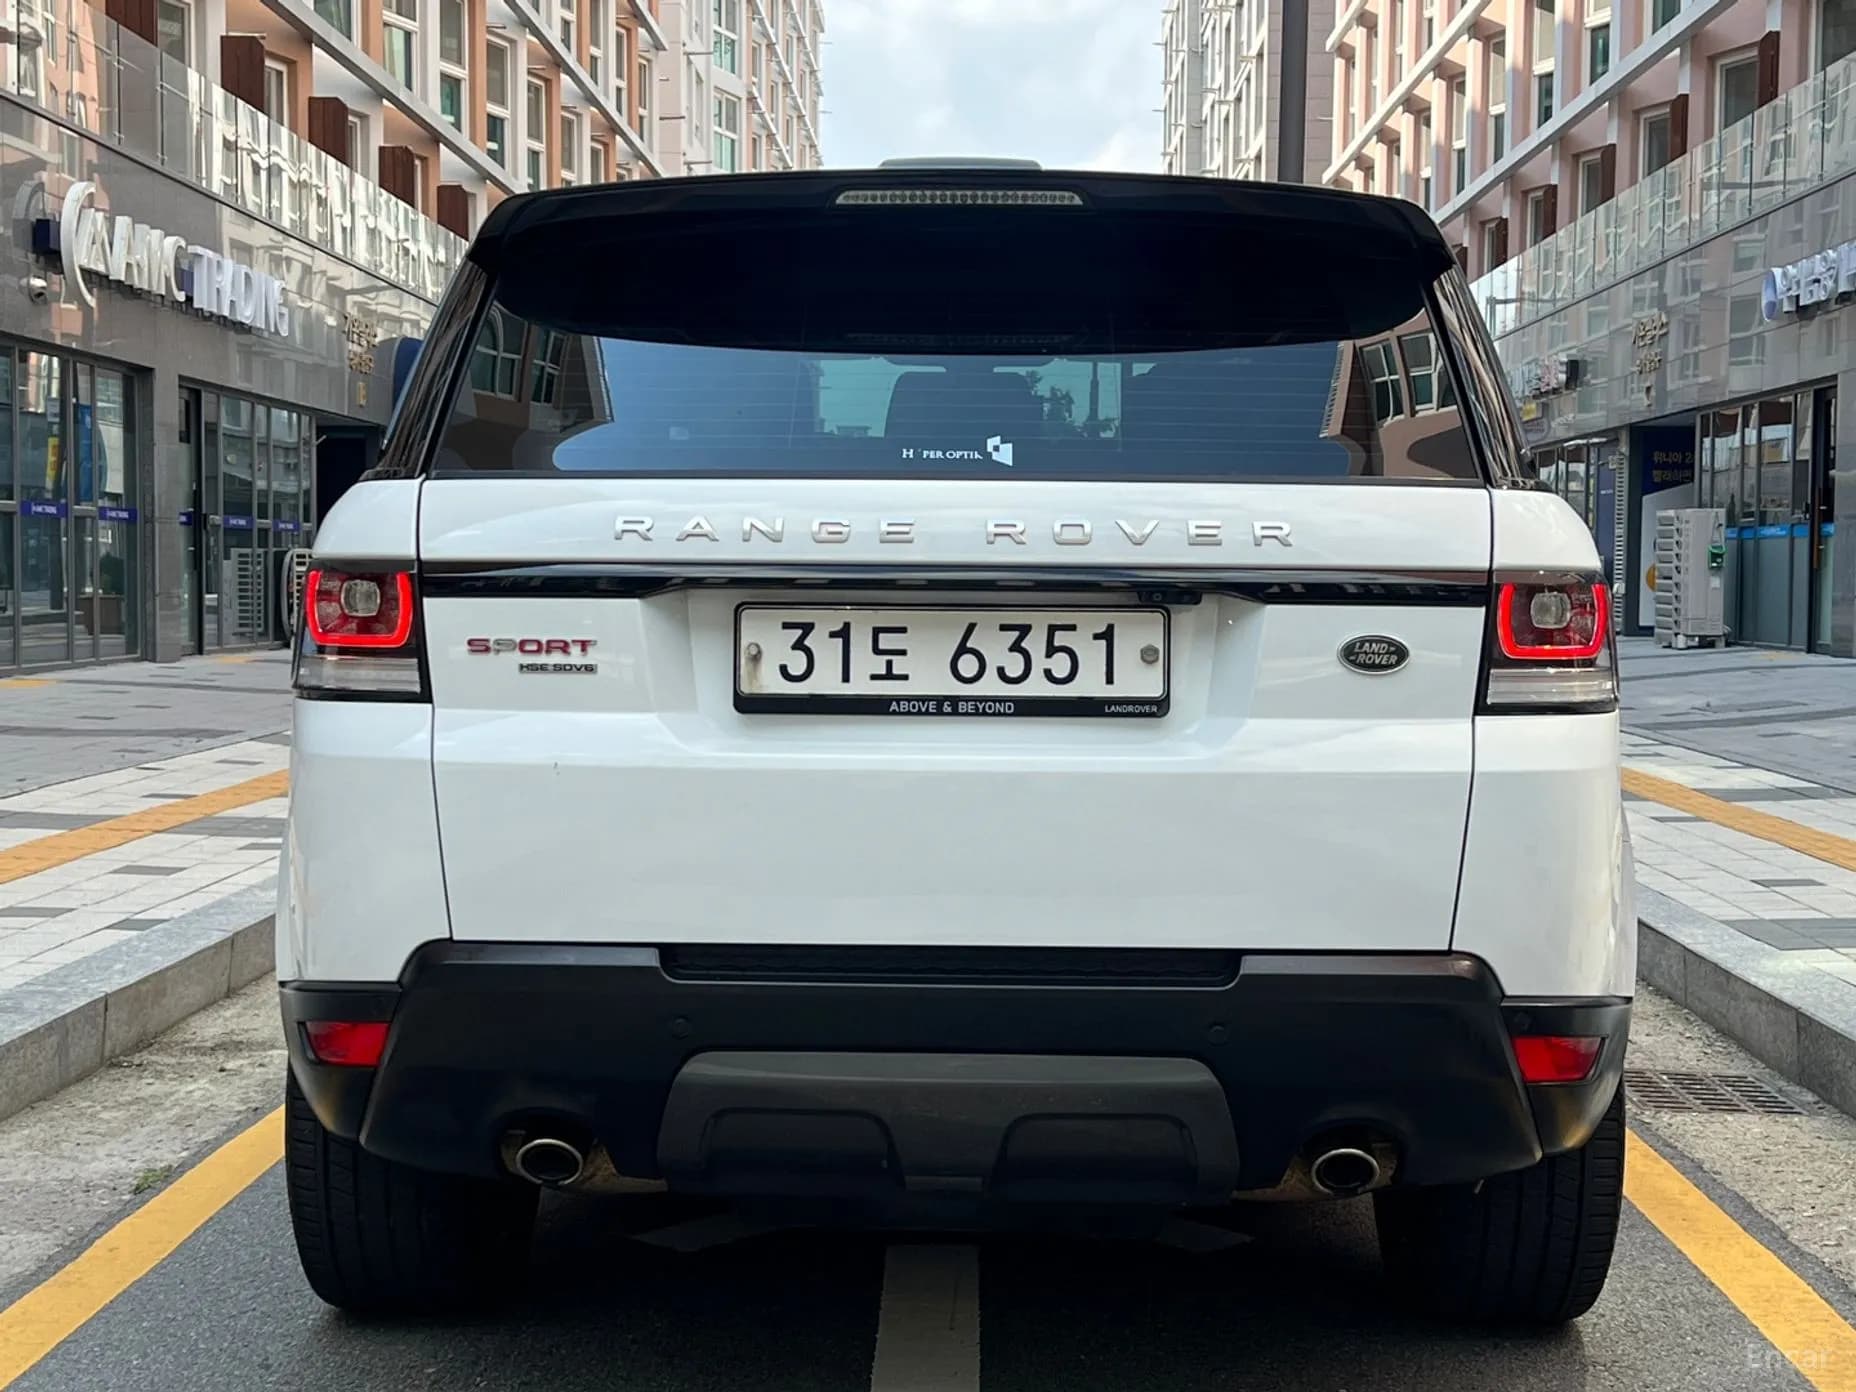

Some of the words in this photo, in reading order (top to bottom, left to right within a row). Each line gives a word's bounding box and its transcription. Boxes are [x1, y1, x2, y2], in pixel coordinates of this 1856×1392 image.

[188, 244, 289, 337] TRADING
[902, 448, 944, 459] HPER
[614, 515, 914, 544] RANGE
[985, 519, 1292, 547] ROVER
[467, 638, 597, 656] SPORT
[778, 621, 910, 683] 31도
[949, 622, 1115, 685] 6351
[1354, 642, 1388, 653] LAND
[1356, 653, 1398, 664] ROVER
[520, 663, 549, 672] HSE
[553, 664, 594, 672] SDV6
[889, 701, 937, 713] ABOVE
[942, 701, 952, 713] &
[958, 702, 1015, 714] BEYOND
[1105, 704, 1158, 713] LANDROVER
